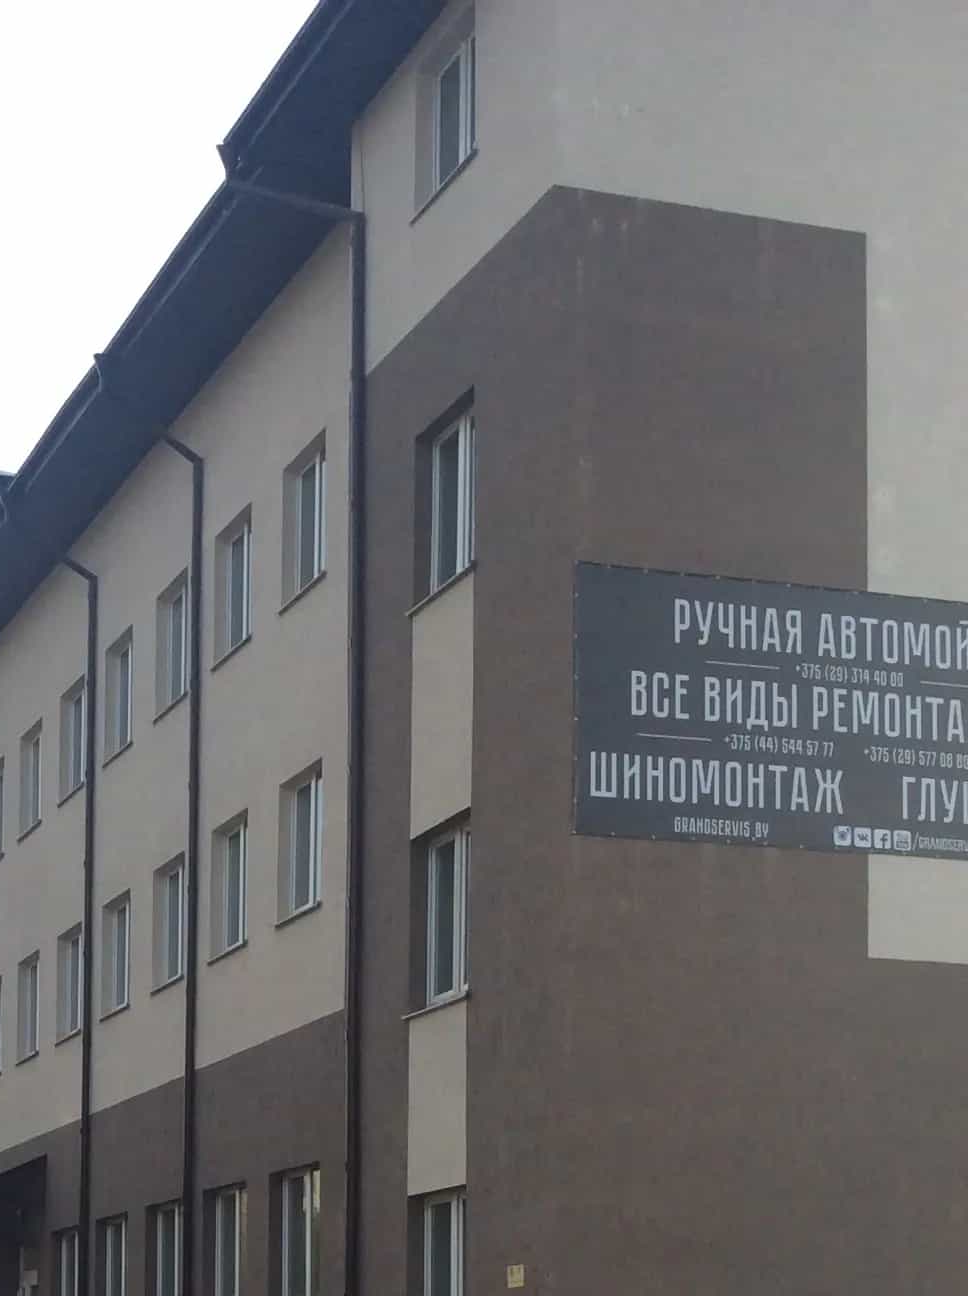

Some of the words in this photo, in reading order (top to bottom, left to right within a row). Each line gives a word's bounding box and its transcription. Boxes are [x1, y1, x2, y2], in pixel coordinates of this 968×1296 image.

[674, 598, 802, 655] РУЧНАЯ
[795, 663, 821, 680] +375
[824, 664, 848, 684] (29)
[631, 670, 690, 720] ВСЕ
[704, 676, 798, 732] ВИДЫ
[812, 685, 965, 743] РЕМОНТА
[724, 733, 751, 751] +375
[754, 735, 778, 754] (44)
[782, 737, 803, 755] 544
[806, 739, 819, 757] 57
[863, 746, 889, 763] +375
[892, 747, 916, 766] (29)
[918, 749, 937, 767] 577
[590, 751, 844, 815] ШИНОМОНТАЖ
